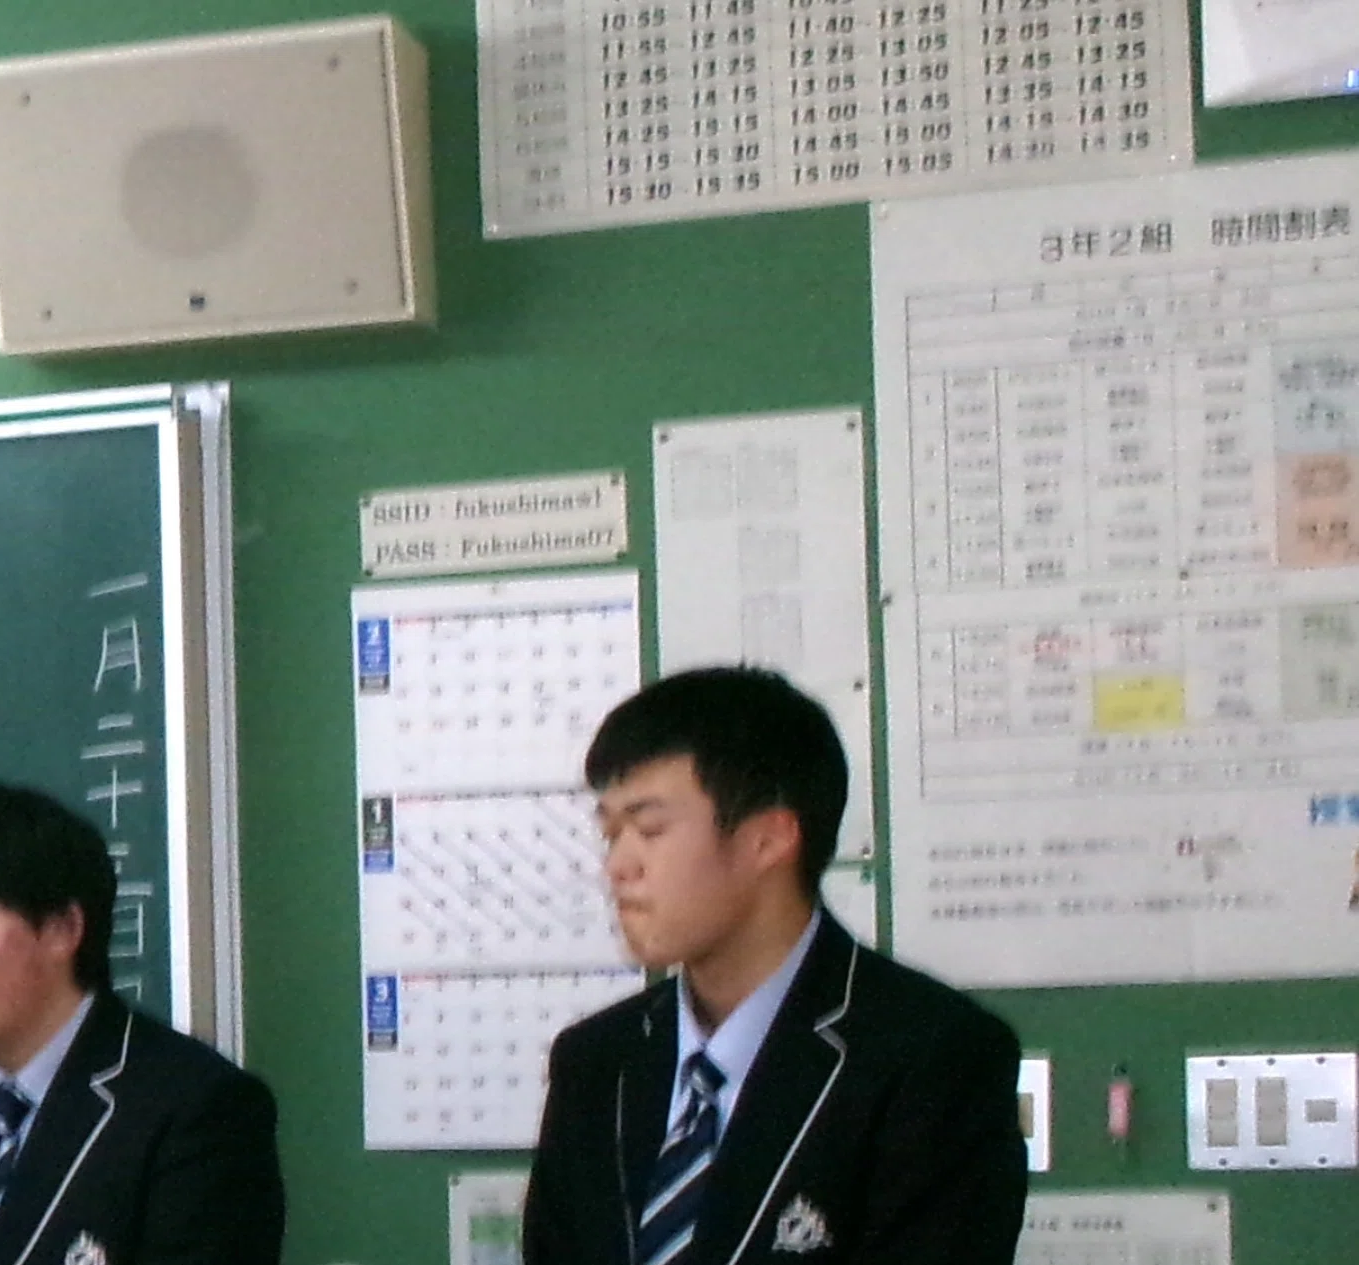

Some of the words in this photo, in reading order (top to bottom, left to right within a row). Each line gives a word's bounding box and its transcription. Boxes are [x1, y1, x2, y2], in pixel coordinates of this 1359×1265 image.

[1040, 217, 1172, 263] 3年2組
[373, 502, 431, 526] SSID
[377, 537, 436, 564] PASS
[375, 981, 388, 1002] 3
